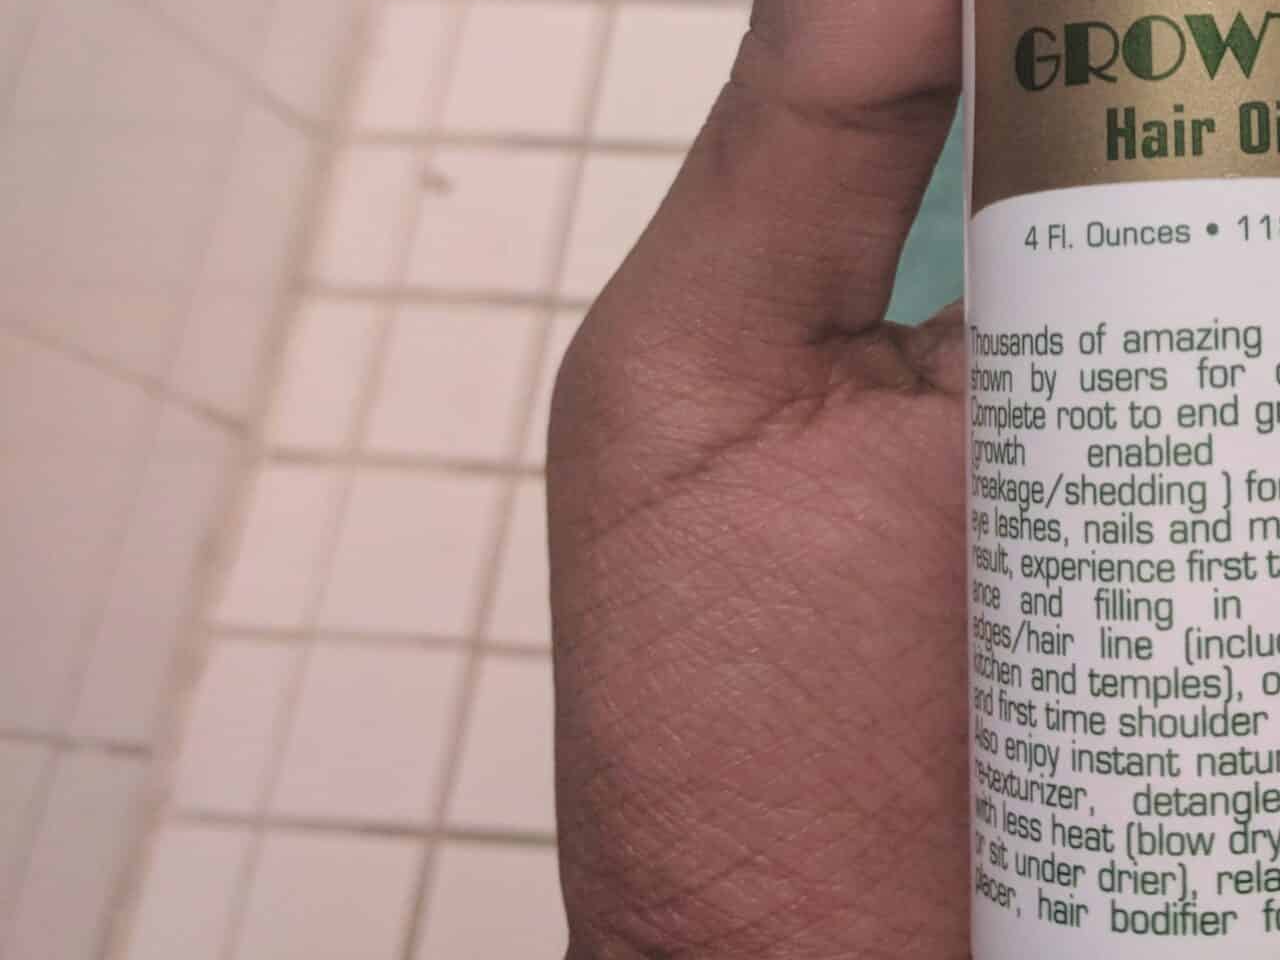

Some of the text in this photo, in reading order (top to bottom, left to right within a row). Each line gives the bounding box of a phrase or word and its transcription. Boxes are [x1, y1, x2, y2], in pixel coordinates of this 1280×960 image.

[1106, 105, 1215, 160] Hair
[1024, 225, 1037, 250] 4
[1048, 223, 1072, 249] Fl.
[1087, 221, 1190, 247] Ounces
[1123, 318, 1262, 358] amazing
[1080, 367, 1167, 391] users
[1057, 402, 1117, 430] root
[1088, 432, 1212, 468] enabled
[995, 507, 1068, 547] lashes,
[1084, 513, 1153, 544] nails
[972, 544, 1013, 578] result,
[1021, 550, 1175, 587] experience
[1186, 550, 1257, 583] first
[1094, 588, 1173, 631] filling
[1101, 627, 1152, 660] line
[1088, 665, 1242, 708] temples),
[999, 689, 1037, 728] first
[1046, 700, 1105, 735] time
[1119, 704, 1269, 738] shoulder
[1005, 734, 1059, 777] enjoy
[1071, 741, 1180, 777] instant
[975, 759, 1094, 816] re-texturizer,
[1003, 800, 1041, 842] less
[1052, 814, 1114, 852] heat
[1126, 821, 1215, 860] (blow
[1016, 852, 1085, 888] under
[1098, 860, 1198, 901] drier),
[975, 864, 1021, 918] placer,
[1038, 888, 1088, 928] hair
[1112, 899, 1237, 936] bodifier
